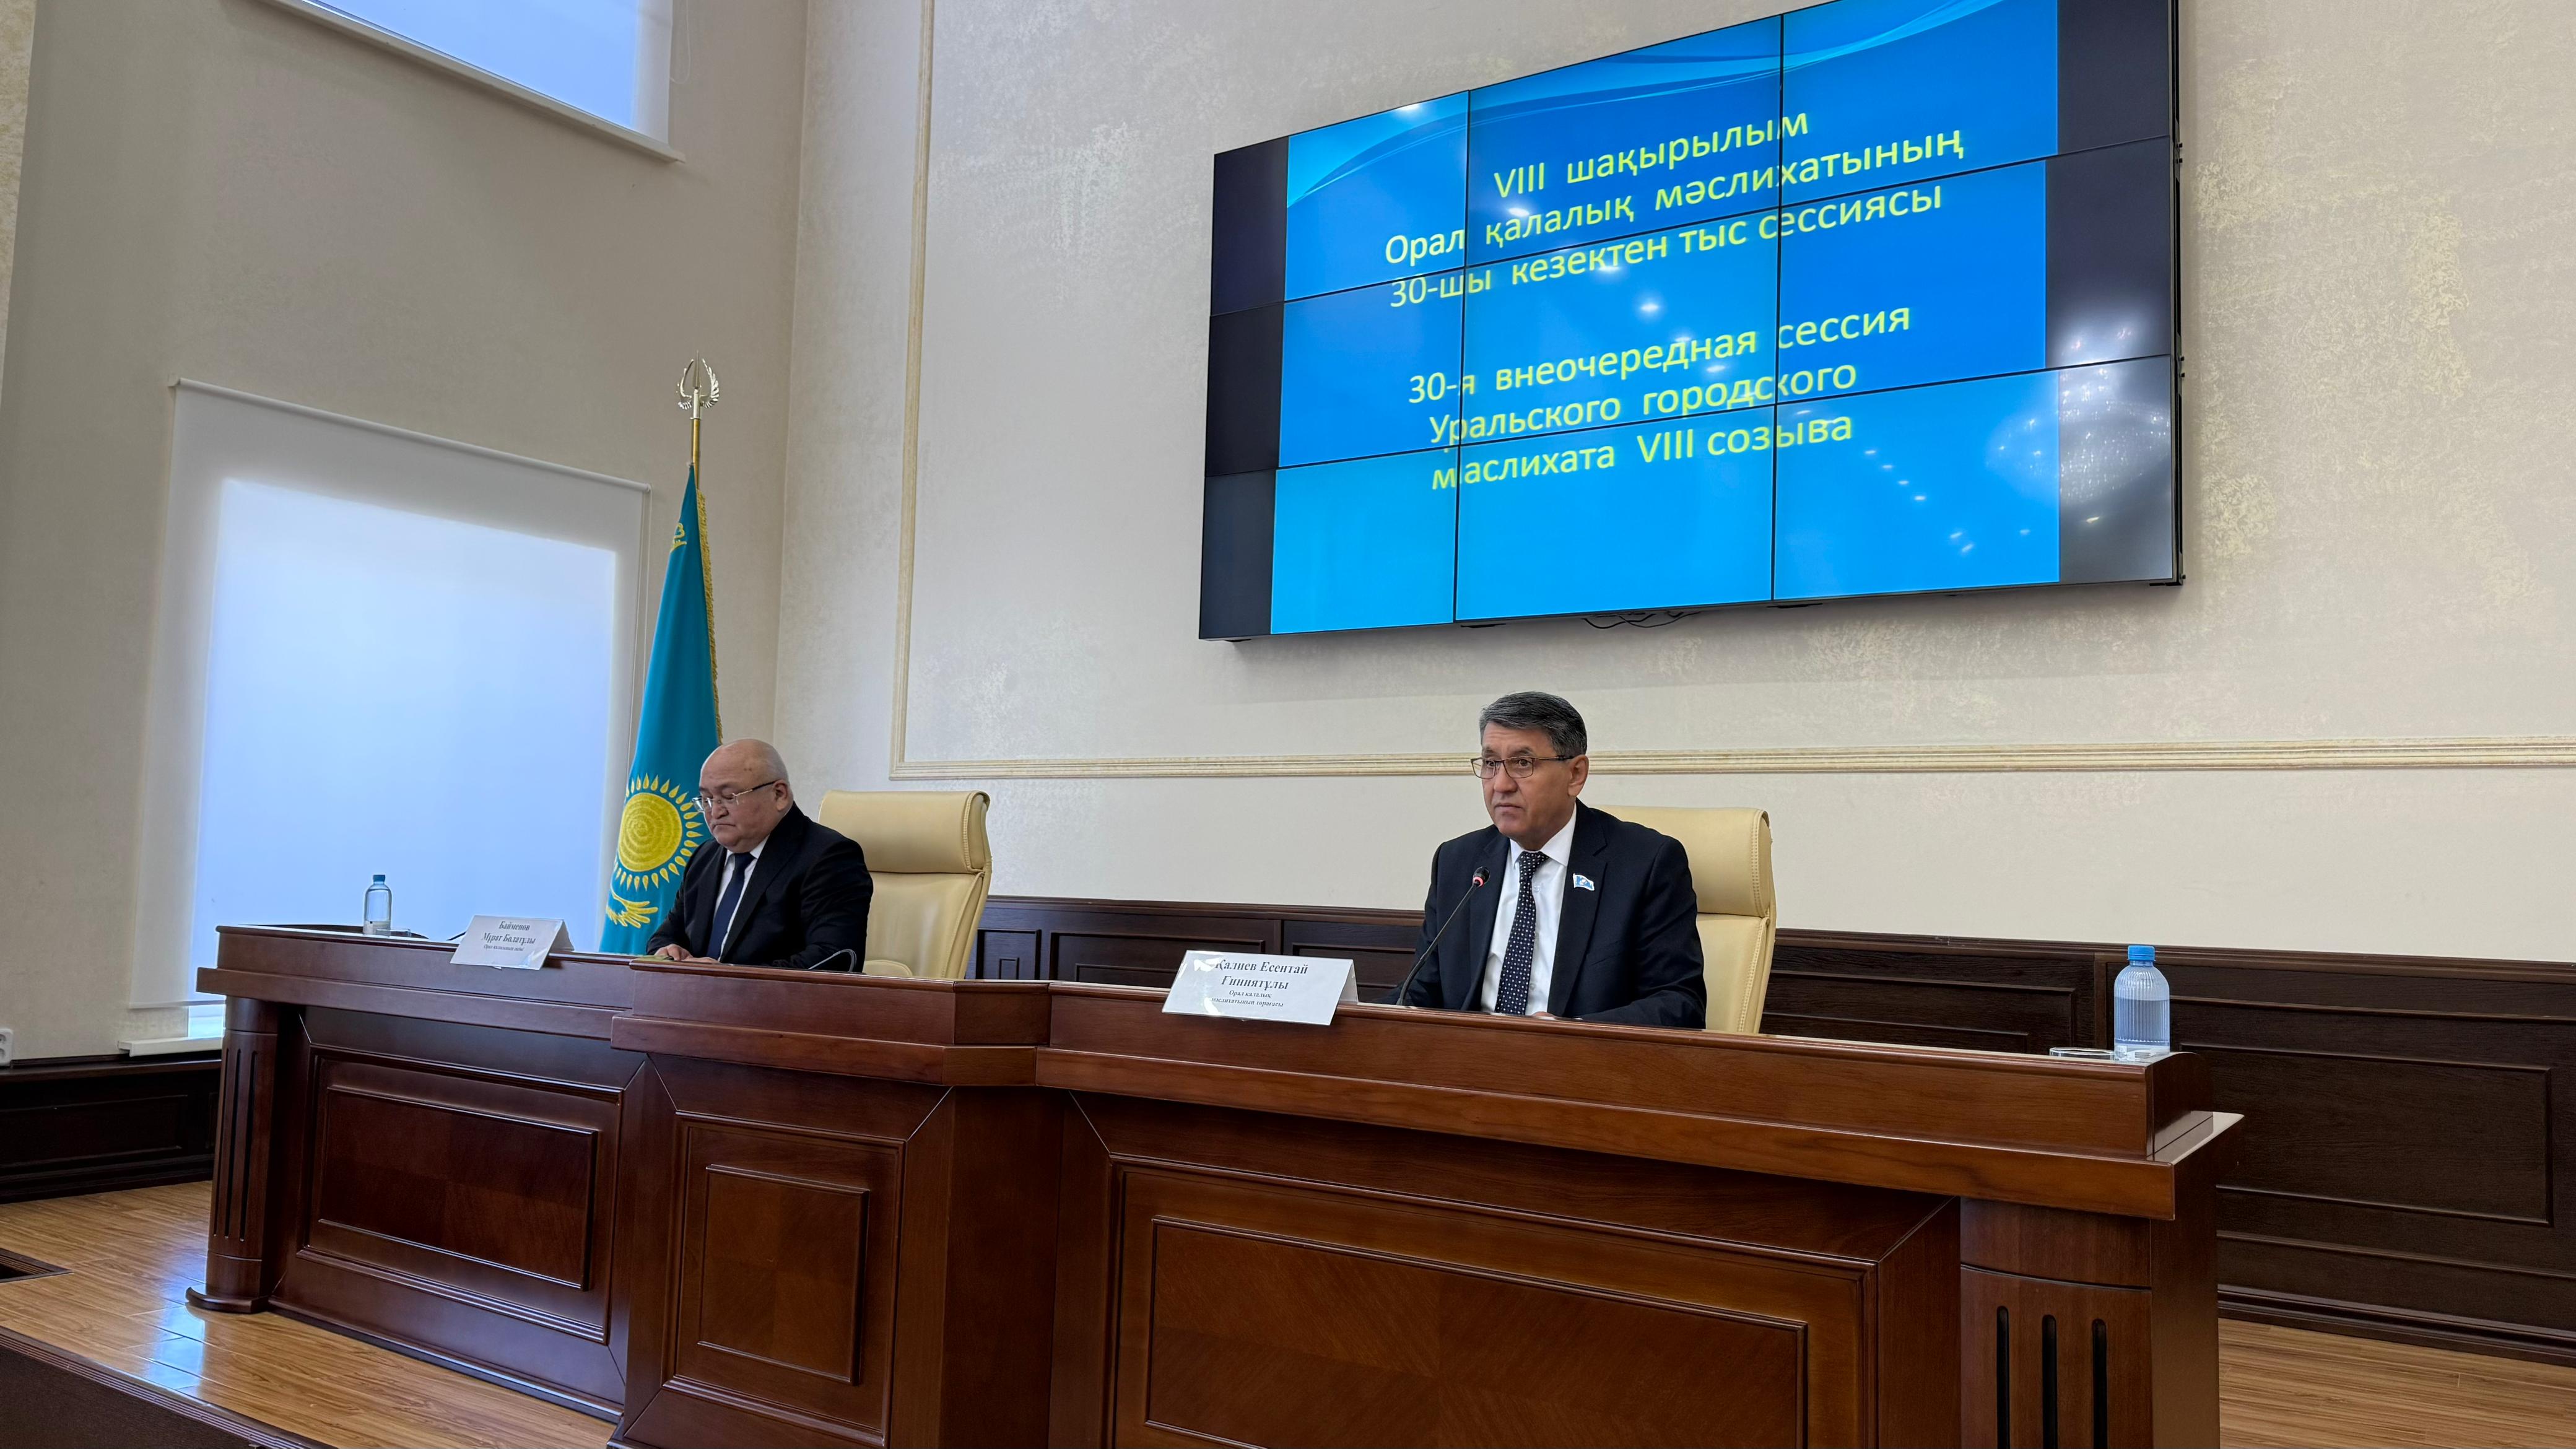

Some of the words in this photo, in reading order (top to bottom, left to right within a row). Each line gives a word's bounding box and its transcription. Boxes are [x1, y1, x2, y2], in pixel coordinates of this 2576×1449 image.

[1494, 163, 1545, 198] VIII
[1567, 113, 1808, 184] шақырылым
[1386, 230, 1465, 266] Орал
[1486, 197, 1635, 246] қалалық
[1656, 131, 1964, 210] мәслихатының
[1390, 271, 1491, 307] 30-шы
[1512, 237, 1668, 285] кезектен
[1679, 221, 1747, 253] тыс
[1759, 186, 1941, 240] сессиясы
[1408, 371, 1475, 404] 30-я
[1496, 331, 1757, 391] внеочередная
[1778, 308, 1910, 349] сессия
[1430, 398, 1621, 451] Уральского
[1643, 365, 1856, 417] городского
[1432, 445, 1615, 489] маслихата
[1637, 429, 1694, 463] VIII
[1708, 416, 1852, 456] созыва
[498, 921, 531, 931] Байменов
[1260, 961, 1308, 974] Есентай
